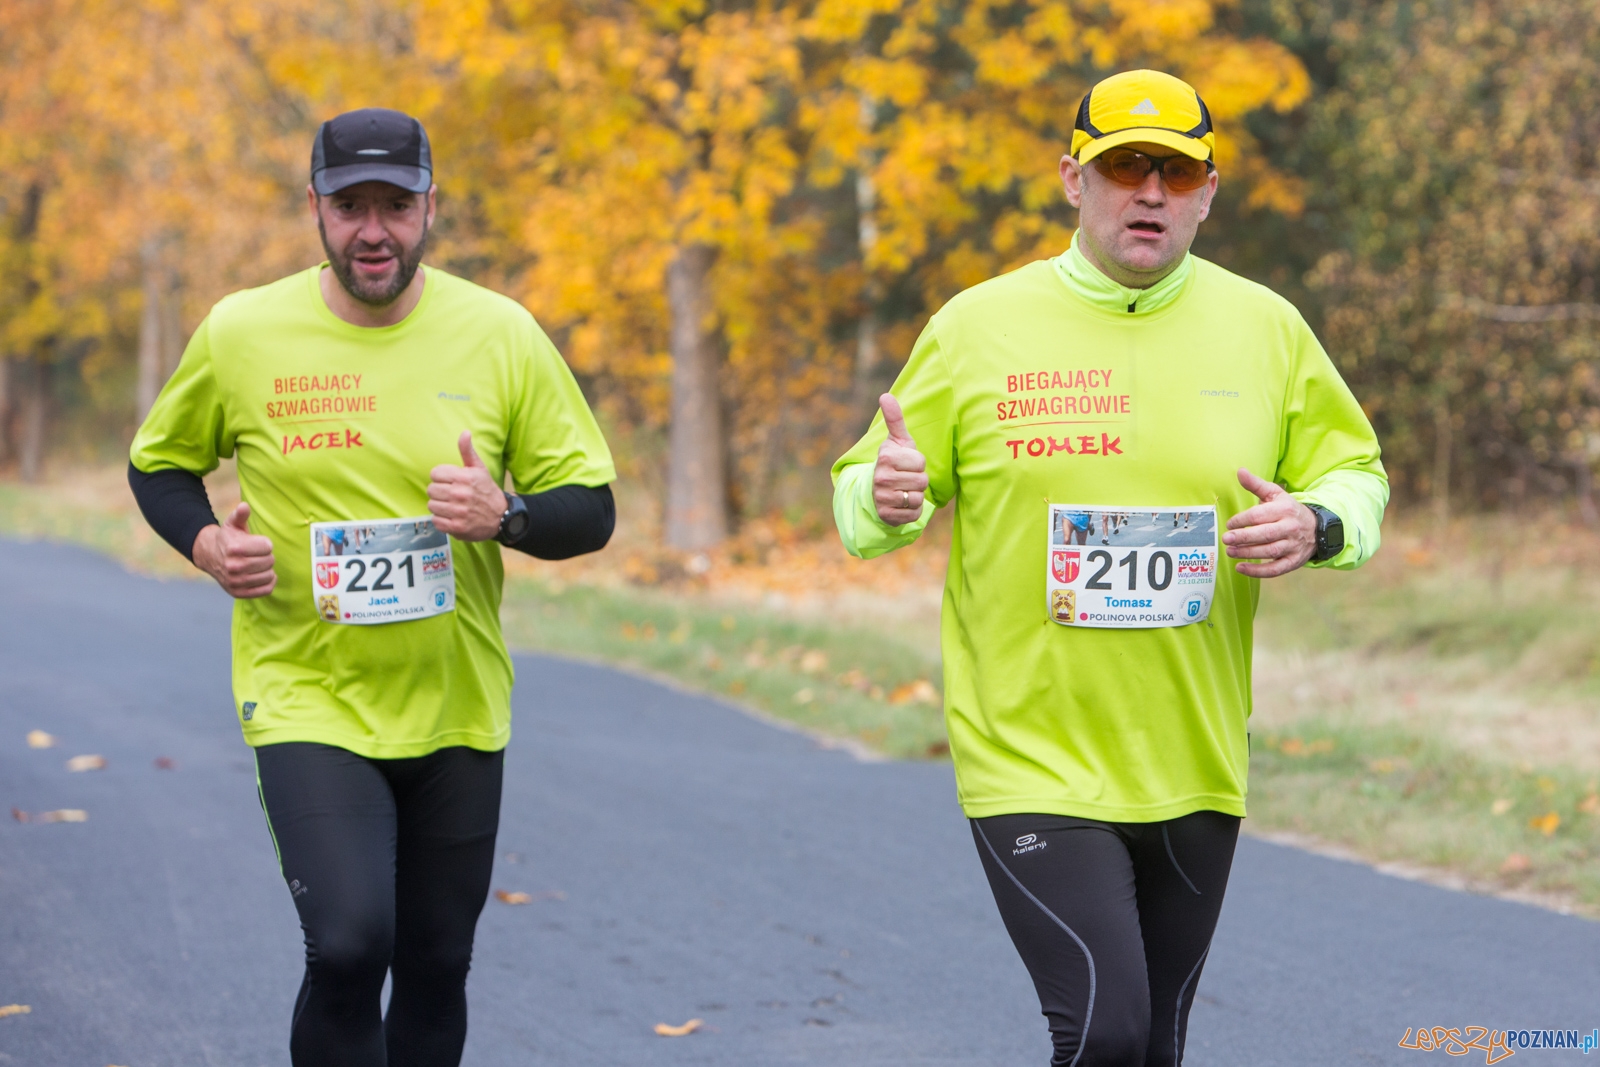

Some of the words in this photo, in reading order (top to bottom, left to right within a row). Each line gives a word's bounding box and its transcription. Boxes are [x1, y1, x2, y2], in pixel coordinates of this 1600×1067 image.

[274, 374, 363, 395] BIEGAJĄCY
[1006, 369, 1113, 393] BIEGAJĄCY
[1199, 388, 1240, 398] martes
[282, 429, 364, 455] JACEK
[1005, 432, 1124, 460] TOMEK
[344, 554, 415, 593] 221
[1084, 549, 1173, 591] 210
[368, 595, 399, 606] Jacek
[1104, 596, 1153, 608] Tomasz
[351, 608, 393, 619] POLINOVA
[394, 606, 425, 616] POLSKA
[1089, 613, 1137, 622] POLINOVA
[1139, 613, 1175, 622] POLSKA
[1012, 840, 1047, 856] Kalenji
